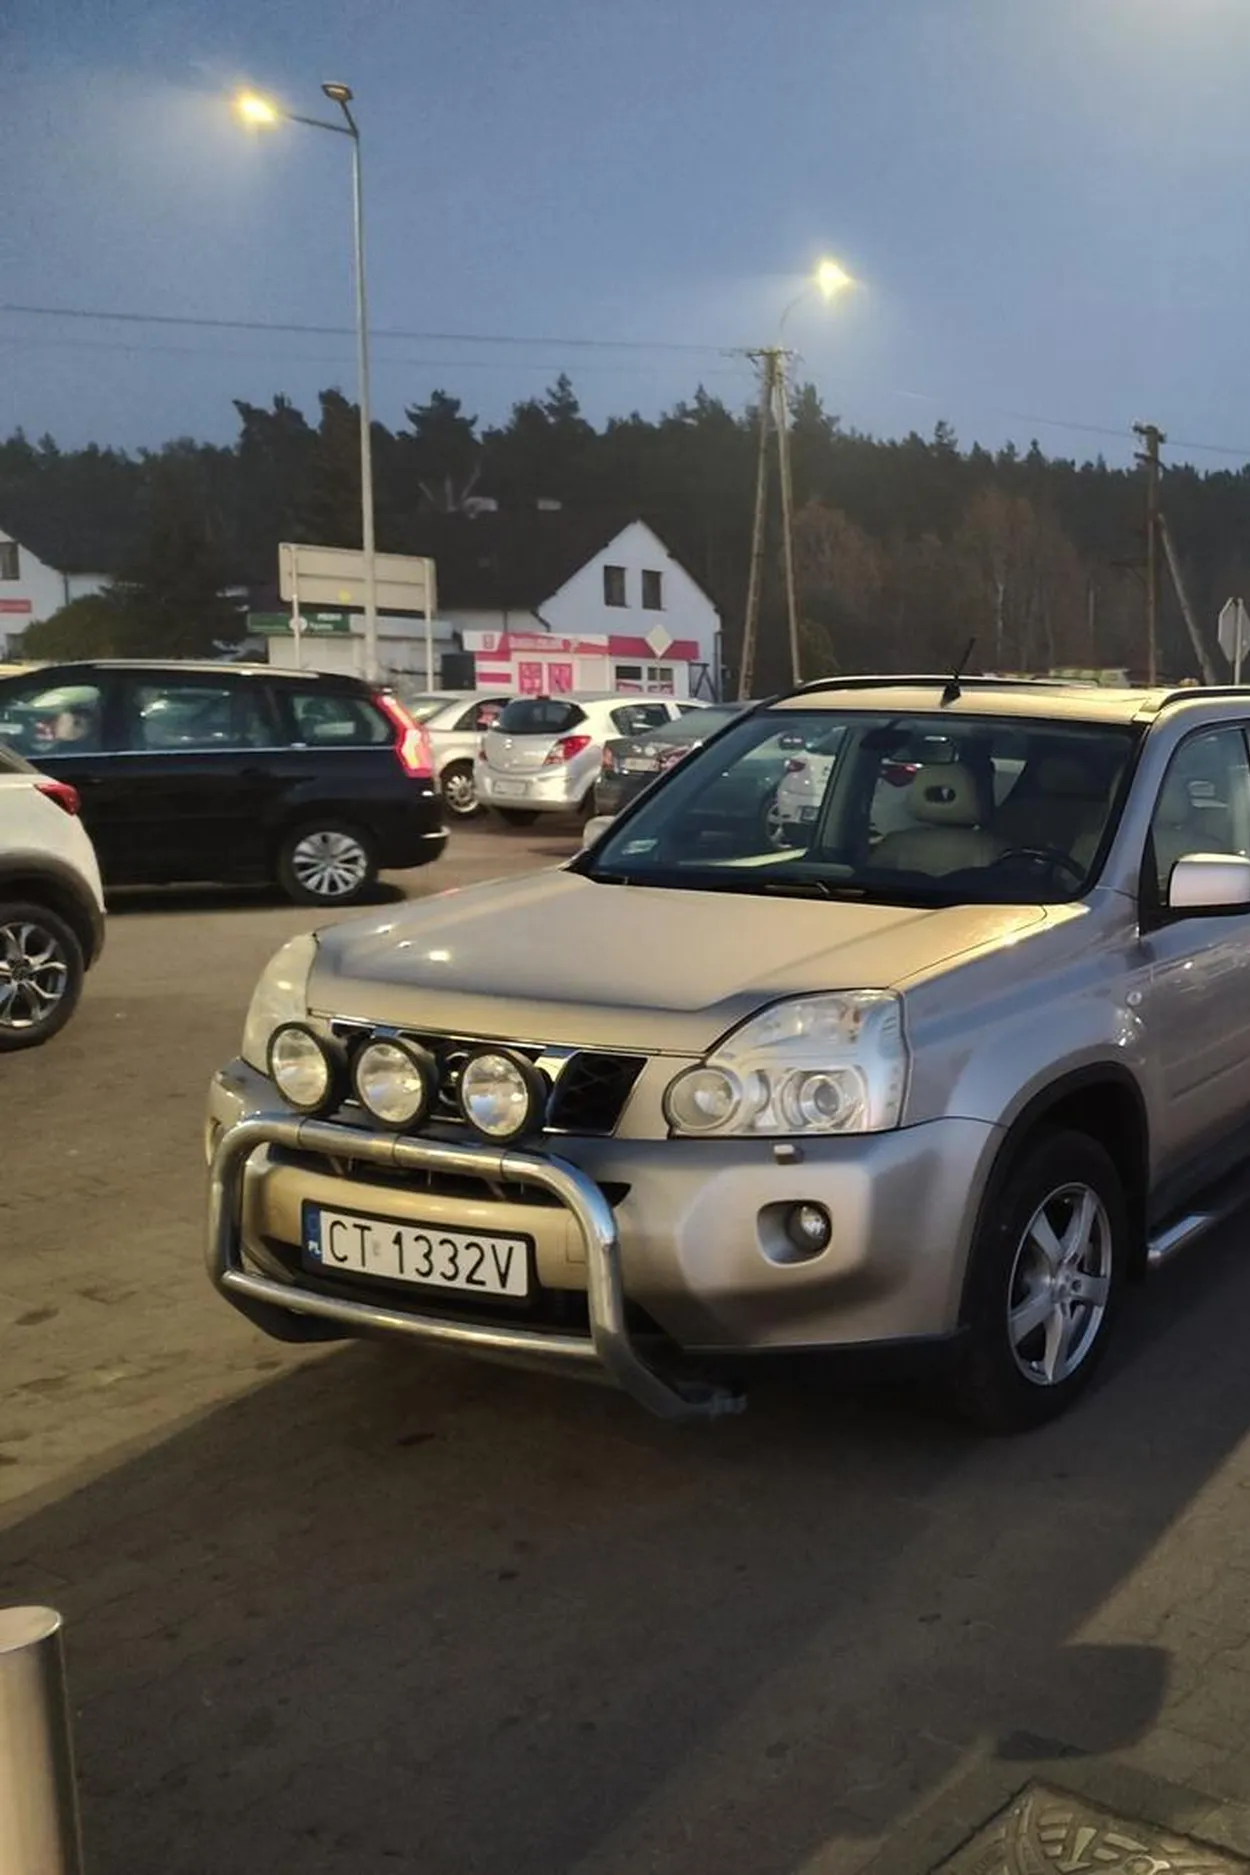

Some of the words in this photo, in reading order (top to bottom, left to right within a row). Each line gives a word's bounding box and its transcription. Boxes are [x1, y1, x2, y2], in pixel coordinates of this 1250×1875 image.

[308, 1241, 321, 1255] PL
[329, 1220, 371, 1267] CT
[392, 1231, 514, 1289] 1332V
